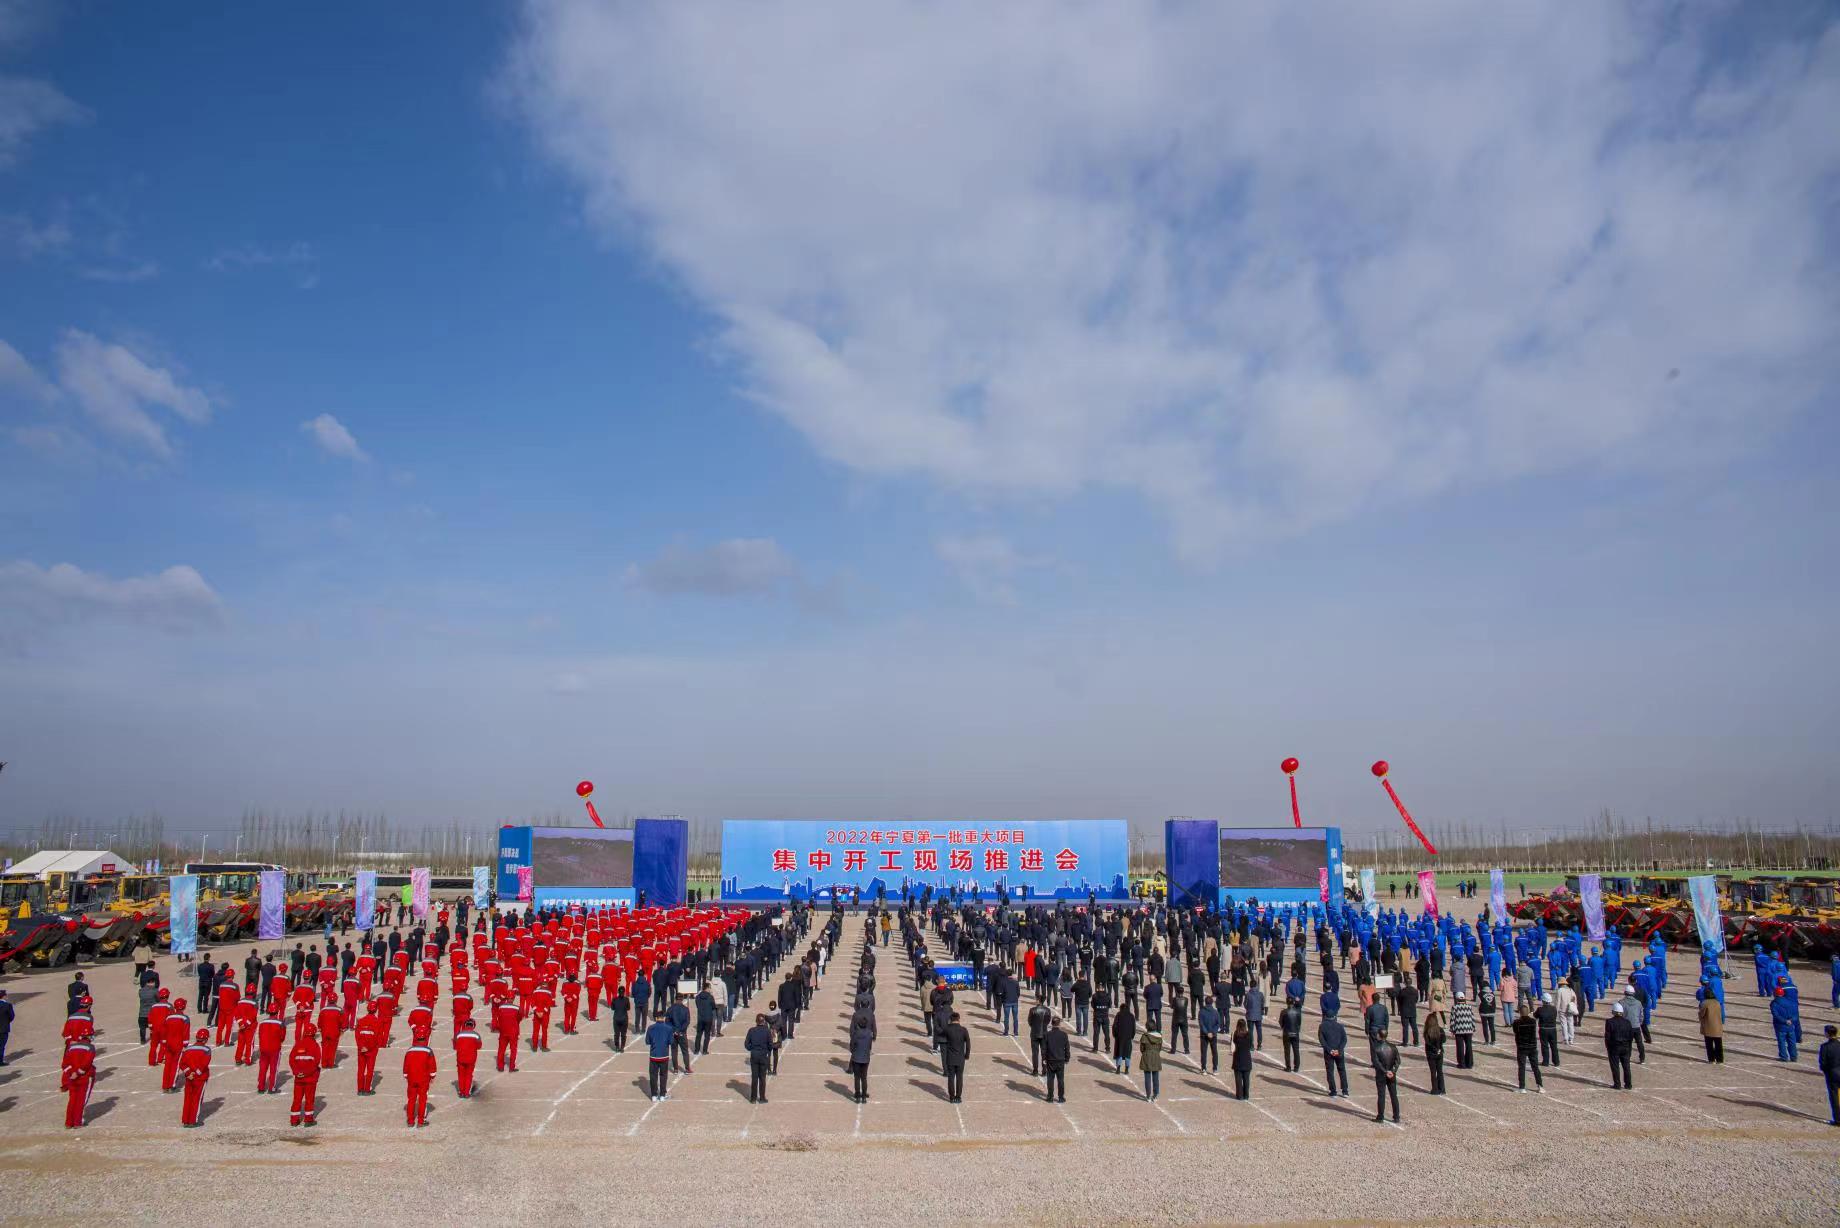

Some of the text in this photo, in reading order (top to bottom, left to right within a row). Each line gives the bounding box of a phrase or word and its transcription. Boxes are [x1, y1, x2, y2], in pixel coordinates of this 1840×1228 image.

[826, 829, 1025, 845] 2022年宁夏第一批重大项目
[772, 848, 1079, 872] 集中开工现场推进会
